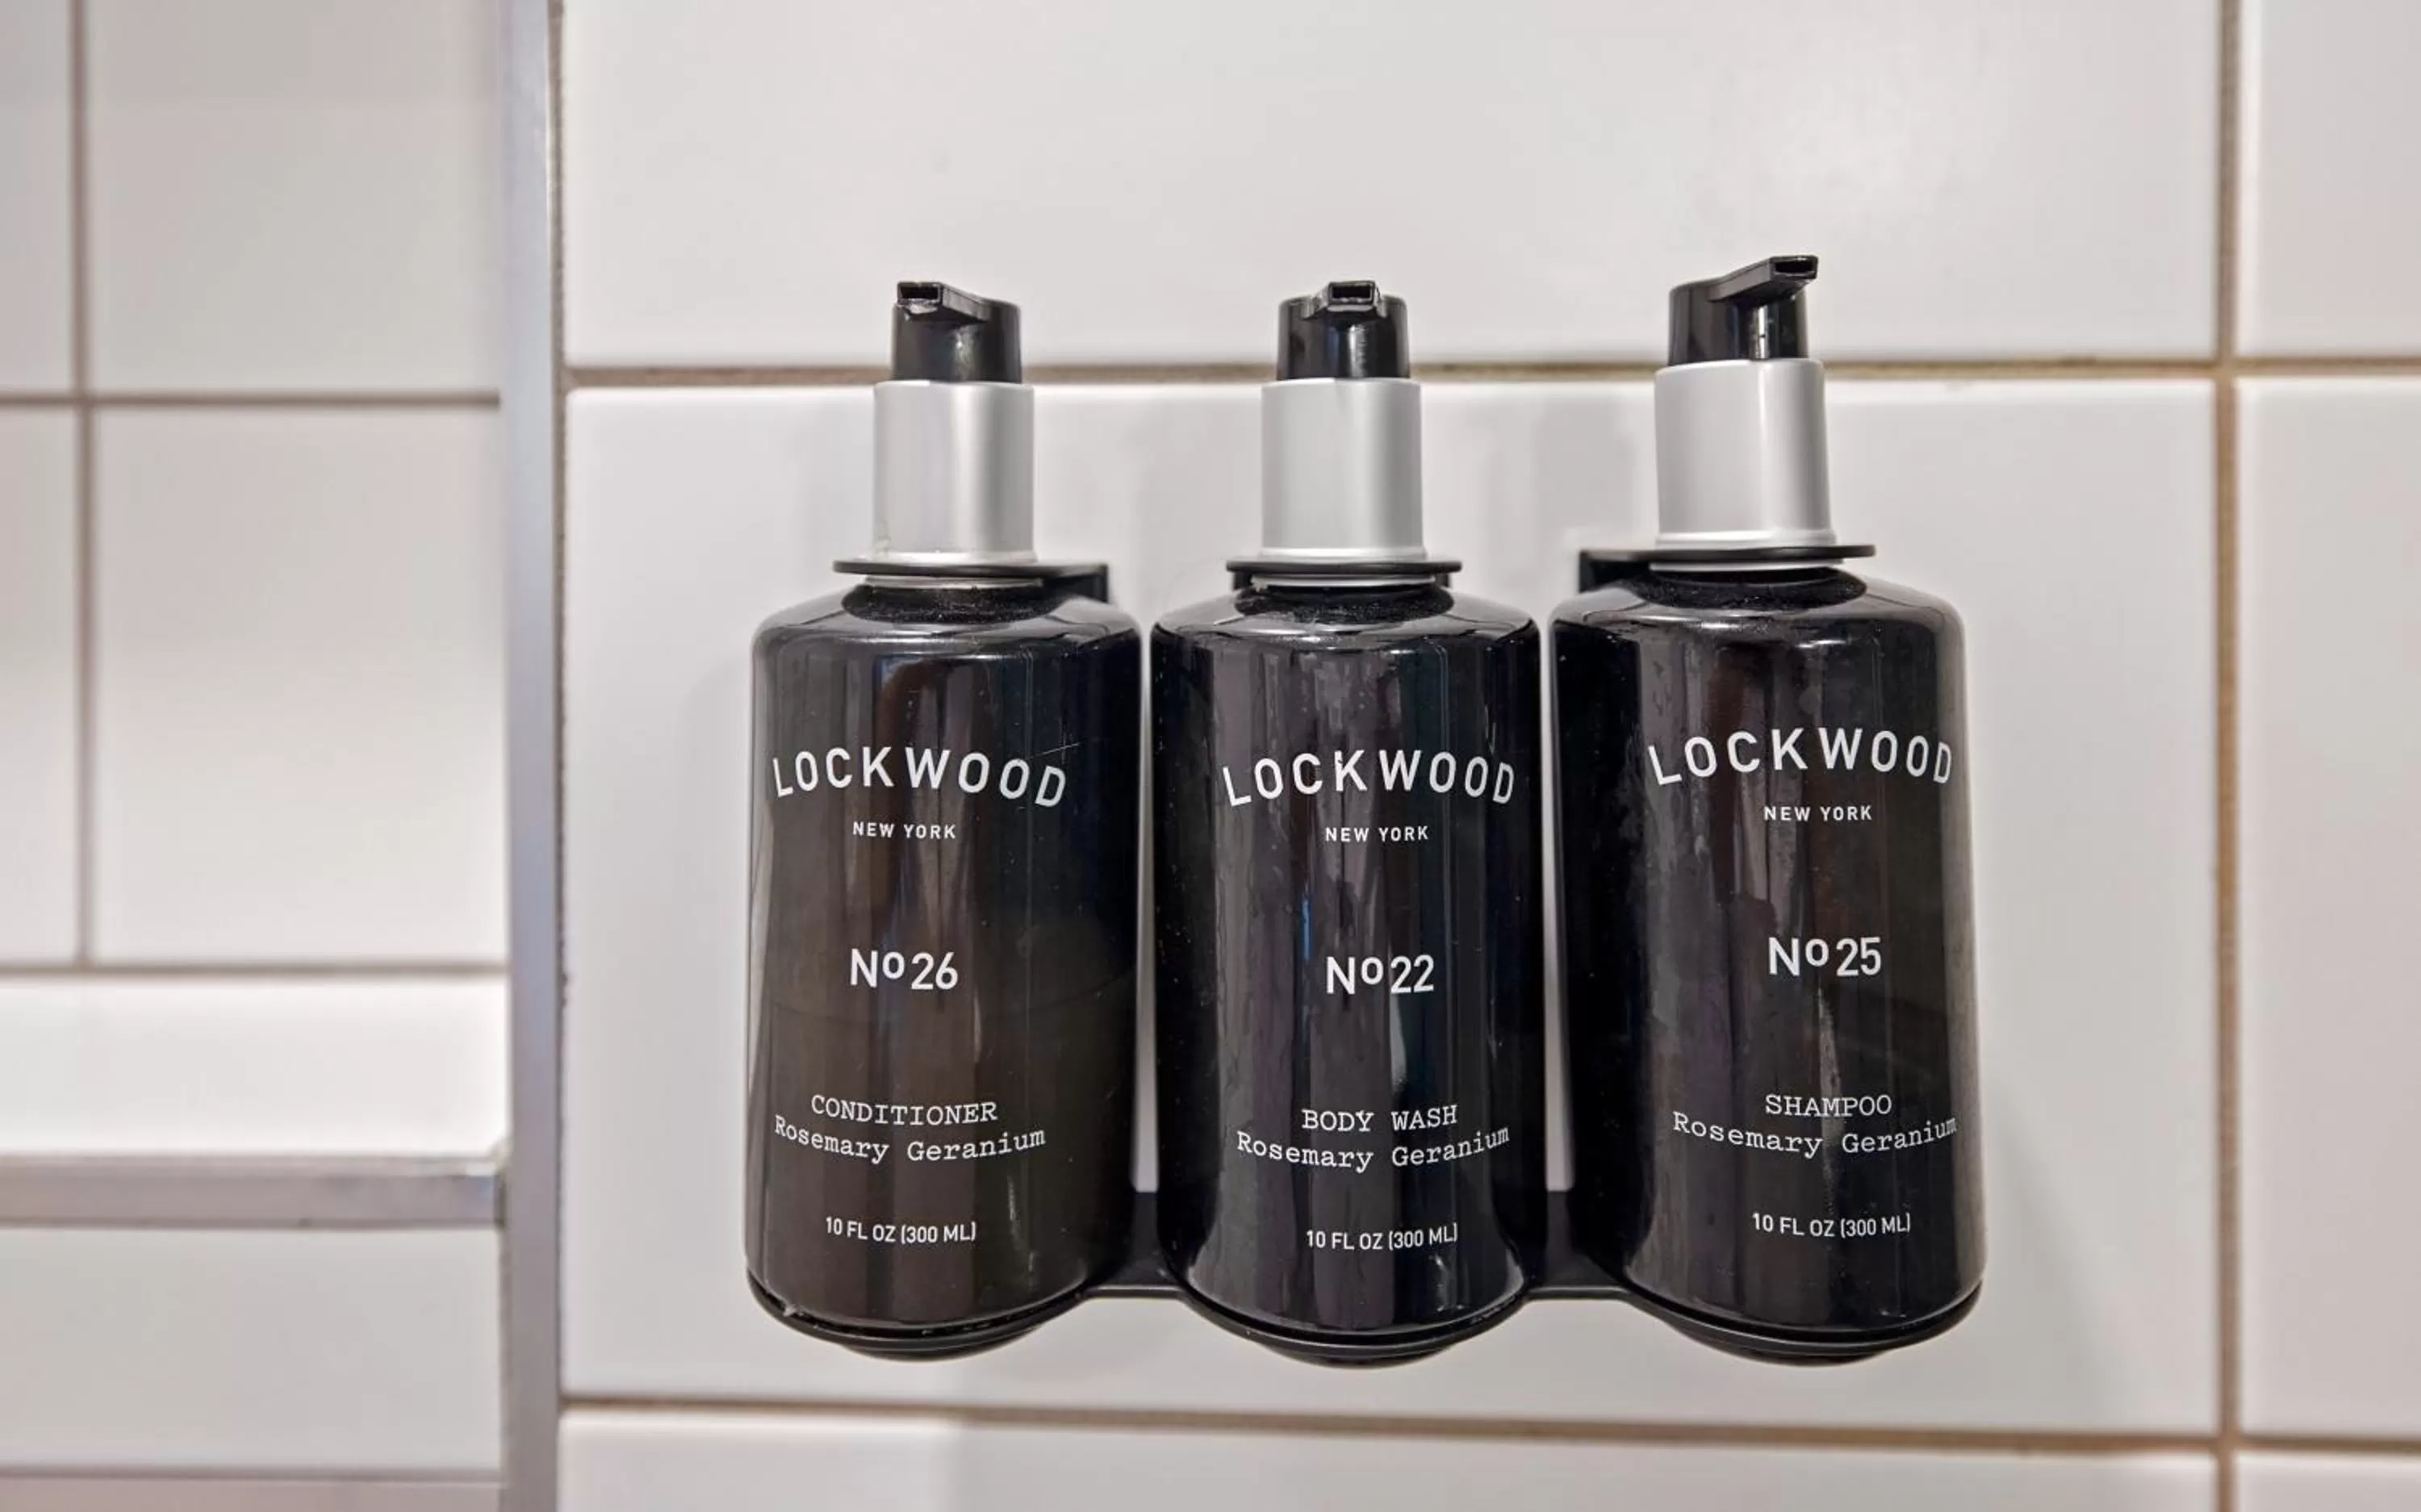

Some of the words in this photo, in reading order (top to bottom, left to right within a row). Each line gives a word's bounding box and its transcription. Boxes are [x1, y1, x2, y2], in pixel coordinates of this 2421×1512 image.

[1647, 727, 1951, 786] LOCKWOOD
[772, 746, 1065, 807] LOCKWOOD
[1223, 750, 1514, 807] LOCKWOOD
[1764, 806, 1810, 821] NEW
[1820, 805, 1871, 821] YORK
[852, 821, 894, 837] NEW
[903, 822, 956, 840] YORK
[1325, 827, 1369, 842] NEW
[1378, 825, 1428, 842] YORK
[811, 1094, 997, 1126] CONDITIONER
[1302, 1109, 1374, 1132] BODY
[1390, 1105, 1457, 1130] WASH
[1765, 1094, 1892, 1117] SHAMPOO
[774, 1114, 889, 1164] Rosemary
[906, 1127, 1047, 1161] Geranium
[1673, 1111, 1823, 1159] Rosemary
[1842, 1116, 1958, 1154] Geranium
[1236, 1130, 1374, 1173] Rosemary
[1391, 1126, 1510, 1167] Geranium
[826, 1216, 843, 1235] 10
[847, 1220, 868, 1240] FL
[872, 1224, 896, 1243] OZ
[1753, 1213, 1774, 1232] 10
[1779, 1217, 1804, 1236] FL
[1809, 1219, 1834, 1237] OZ
[1307, 1230, 1326, 1248] 10
[1332, 1232, 1355, 1250] FL
[1359, 1232, 1382, 1250] OZ
